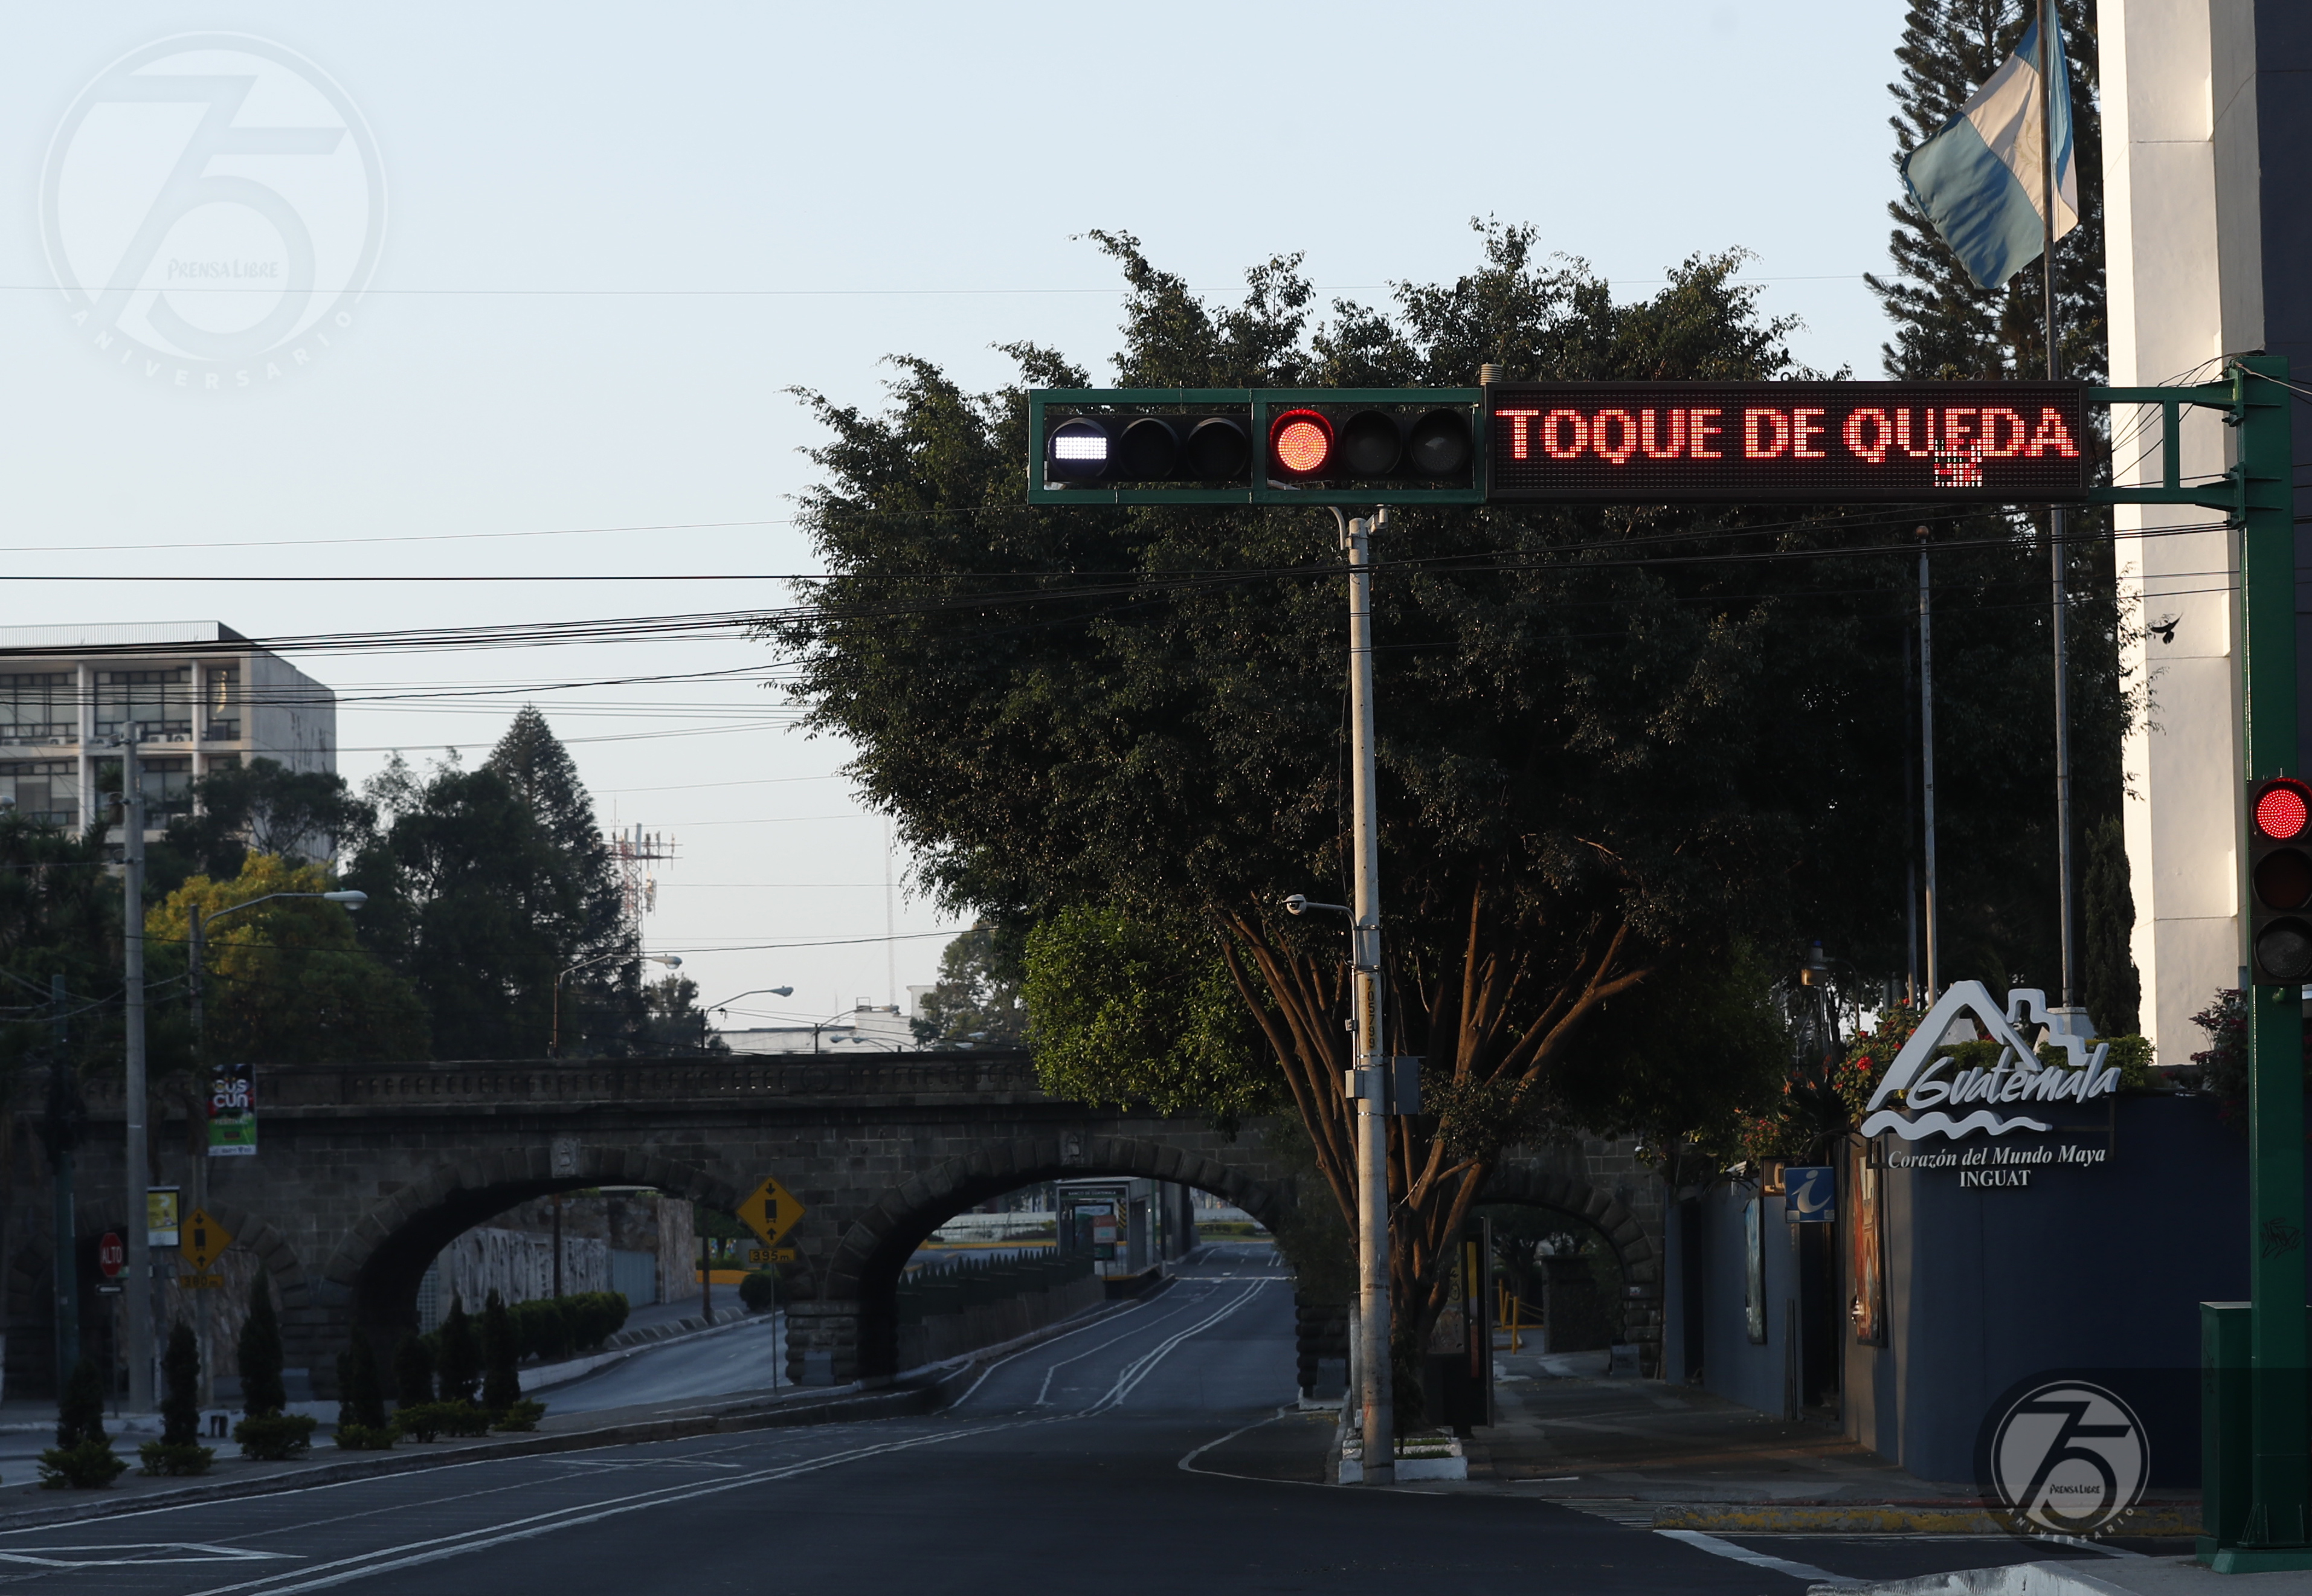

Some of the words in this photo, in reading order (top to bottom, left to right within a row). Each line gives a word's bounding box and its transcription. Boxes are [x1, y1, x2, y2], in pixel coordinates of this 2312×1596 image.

[1495, 408, 1722, 464] TOQUE
[1745, 408, 1825, 459] DE
[1843, 408, 2079, 463] QUEDA
[1907, 1043, 2121, 1110] Guatemala
[1888, 1148, 1957, 1169] Corazón
[1962, 1148, 1986, 1166] del
[1991, 1145, 2053, 1165] Mundo
[2058, 1145, 2106, 1167] Maya
[1960, 1170, 2031, 1187] INGUAT
[101, 1246, 122, 1264] ALTO
[753, 1250, 778, 1261] 395
